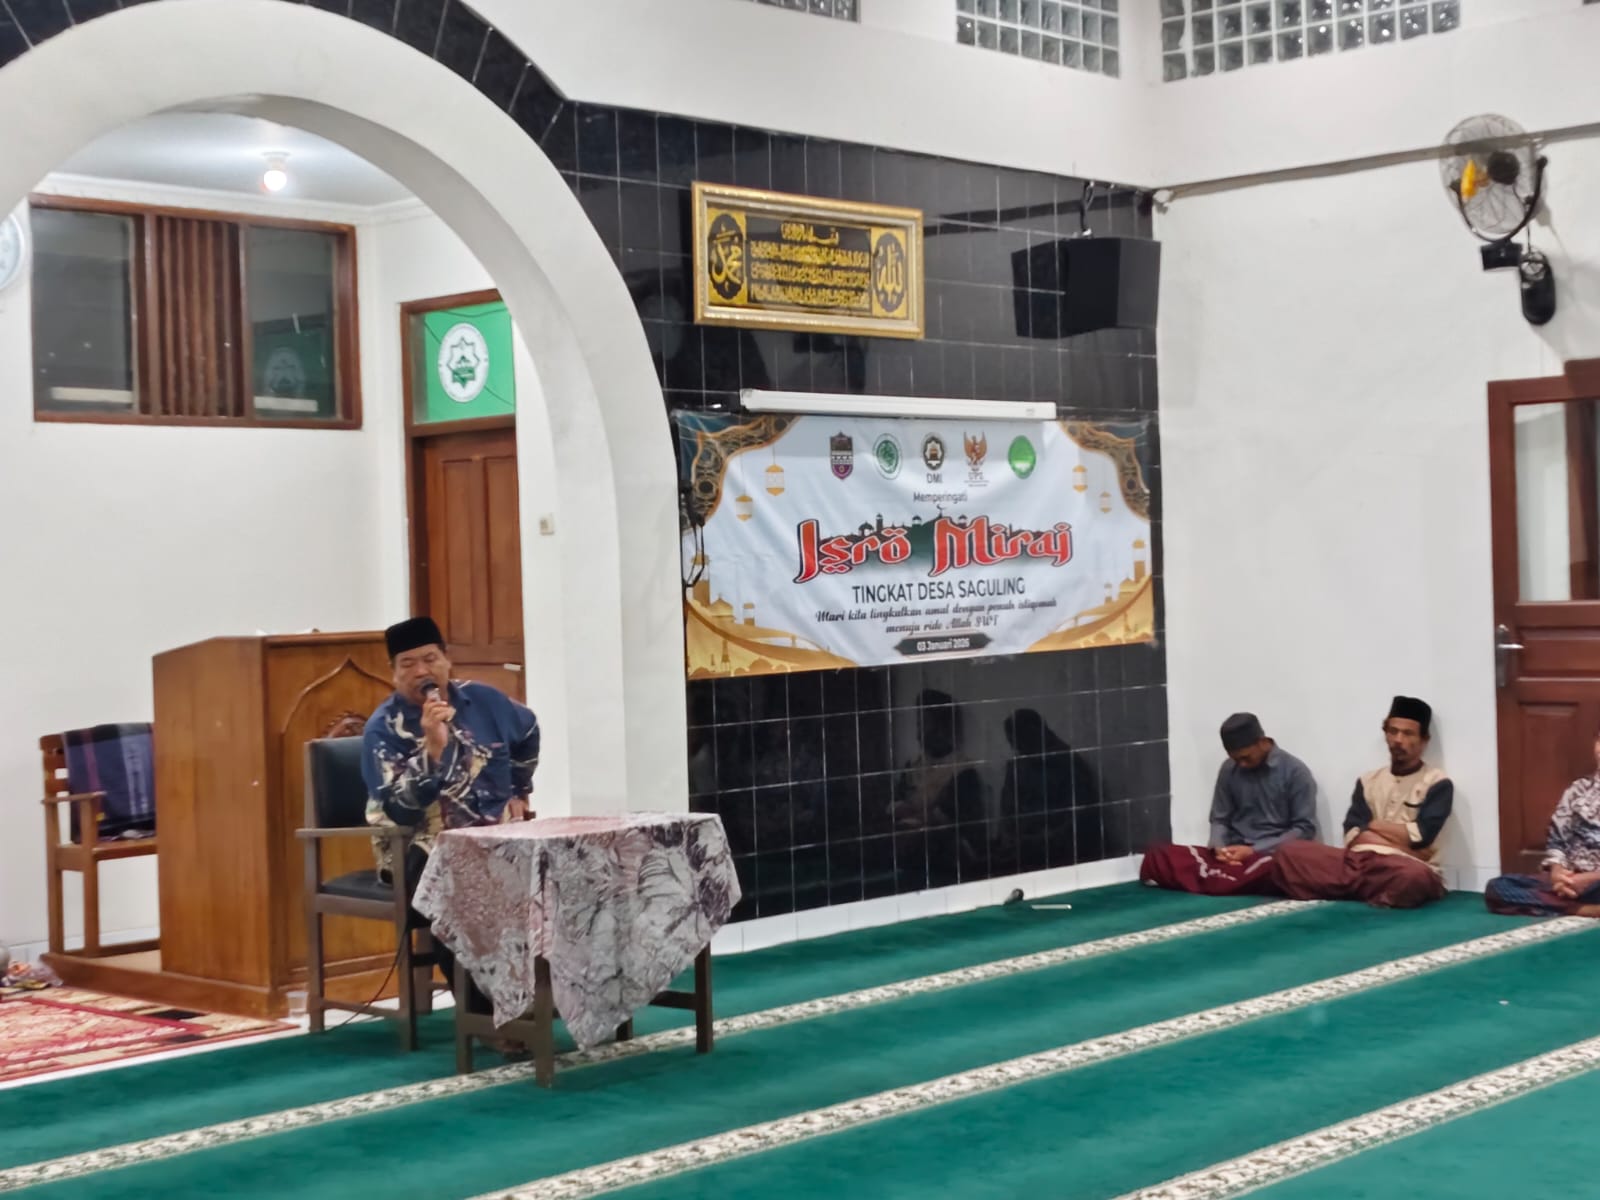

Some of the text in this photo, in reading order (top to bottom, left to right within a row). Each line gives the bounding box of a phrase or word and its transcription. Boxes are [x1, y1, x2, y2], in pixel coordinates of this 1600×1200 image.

[926, 473, 943, 484] DMI
[913, 491, 968, 504] Memperingati
[852, 577, 1026, 604] TINGKAT DESA SAGULING
[816, 609, 846, 622] Mari
[848, 609, 867, 621] kita
